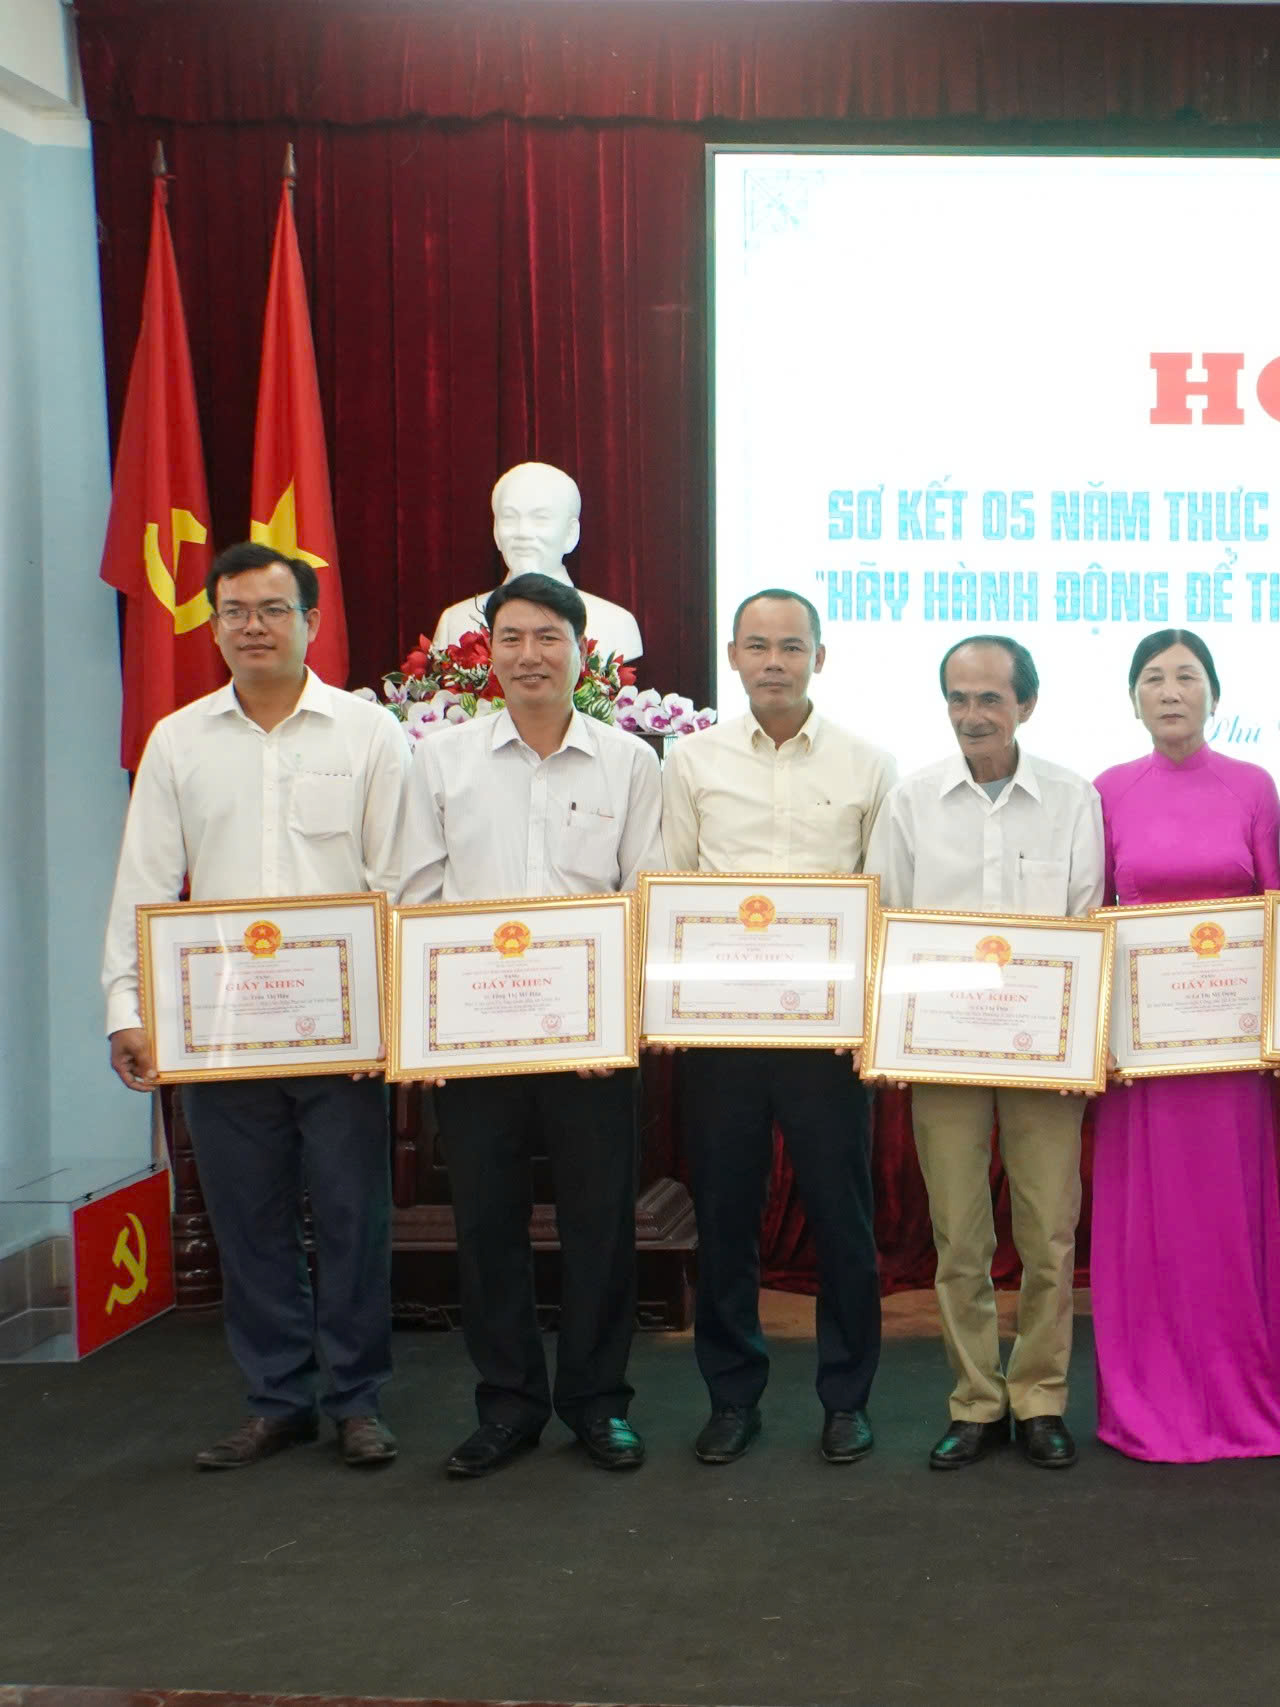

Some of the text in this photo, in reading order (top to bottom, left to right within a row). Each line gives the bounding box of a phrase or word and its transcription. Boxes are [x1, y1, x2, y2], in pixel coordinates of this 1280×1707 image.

[828, 484, 884, 540] SƠ
[898, 475, 968, 540] KẾT
[983, 490, 1035, 540] 05
[1051, 481, 1150, 541] NĂM
[1164, 487, 1269, 554] THỰC
[924, 561, 1038, 623] HÀNH
[1054, 563, 1169, 635] ĐỘNG
[1185, 551, 1239, 623] ĐỂ
